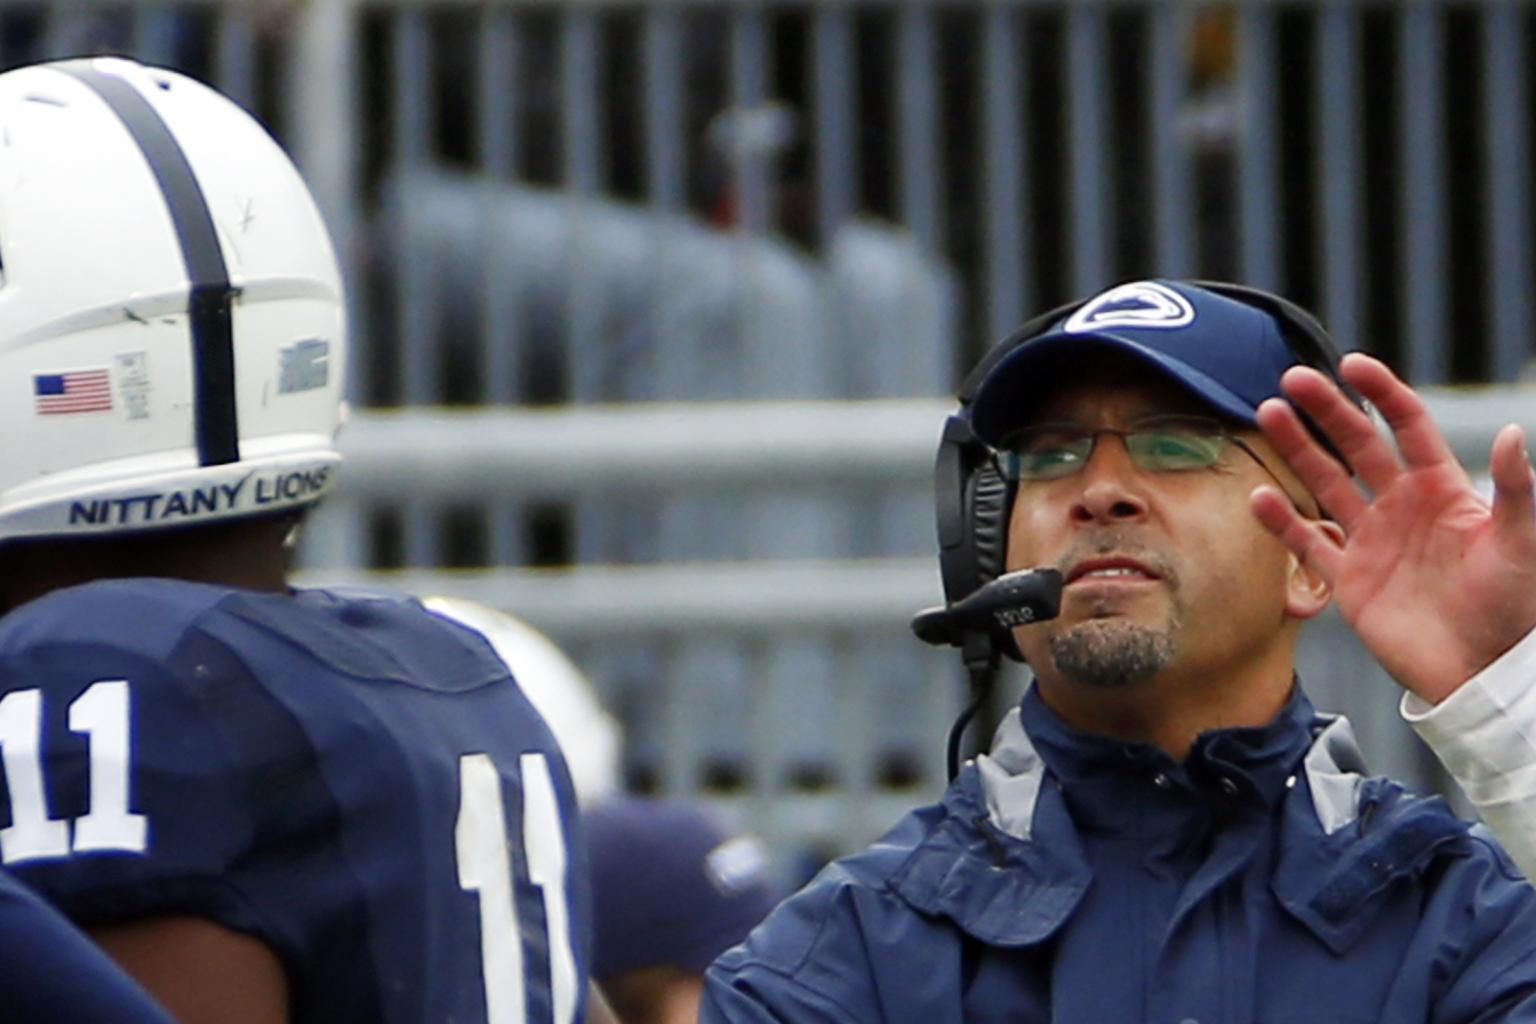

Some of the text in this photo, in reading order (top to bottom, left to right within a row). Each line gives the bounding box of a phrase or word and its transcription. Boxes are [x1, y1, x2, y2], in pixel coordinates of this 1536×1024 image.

[69, 466, 331, 524] NITTANY LIONS
[0, 680, 147, 865] 11
